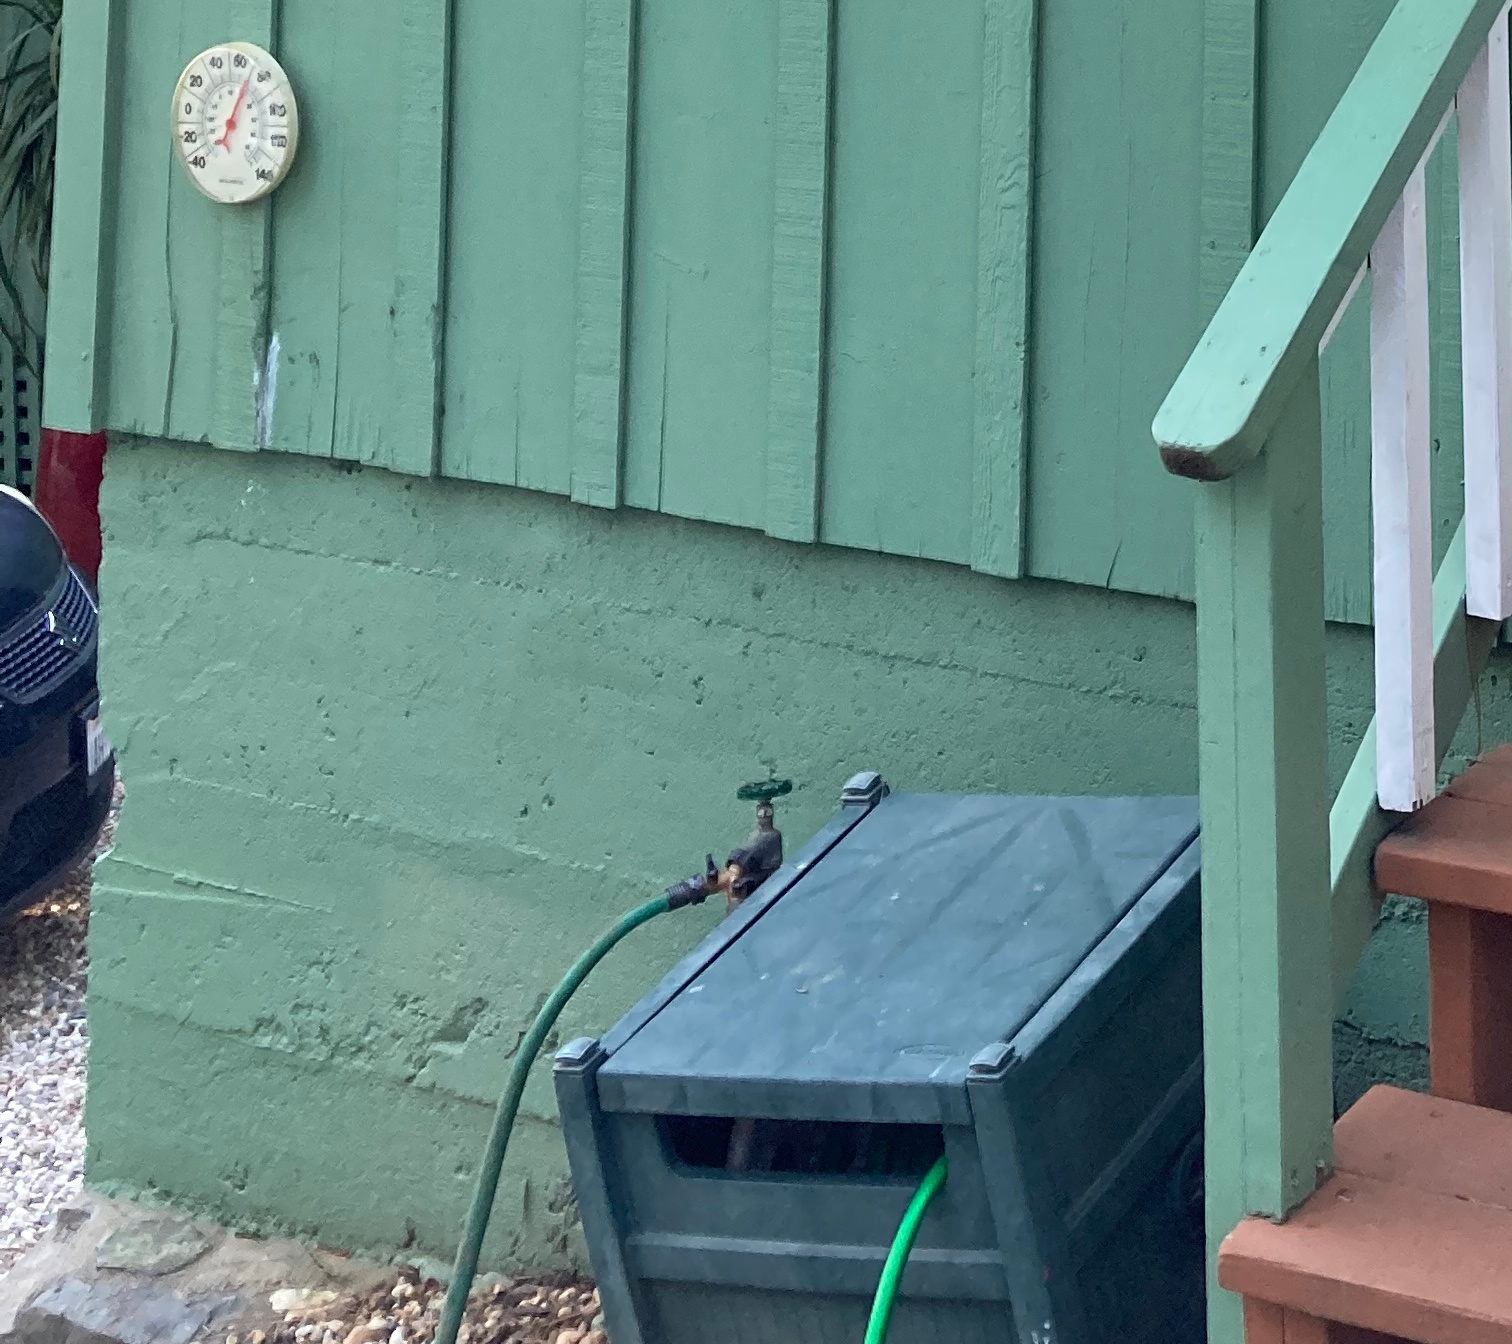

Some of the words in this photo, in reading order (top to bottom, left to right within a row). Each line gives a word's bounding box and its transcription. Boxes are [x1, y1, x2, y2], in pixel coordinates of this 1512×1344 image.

[209, 56, 223, 69] 40
[189, 74, 203, 88] 20
[184, 102, 192, 115] 0
